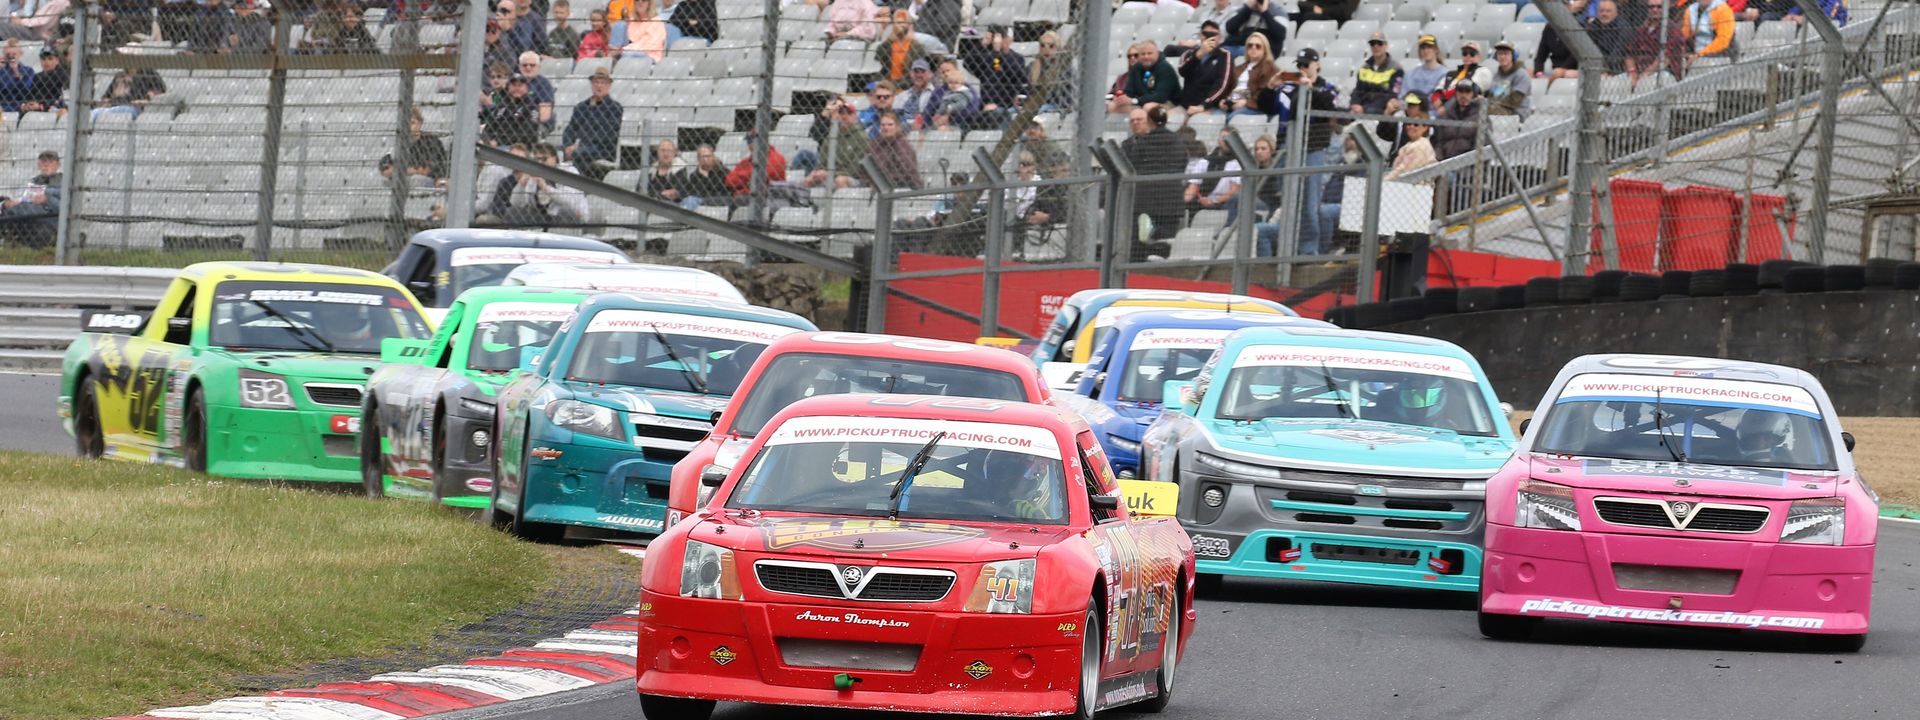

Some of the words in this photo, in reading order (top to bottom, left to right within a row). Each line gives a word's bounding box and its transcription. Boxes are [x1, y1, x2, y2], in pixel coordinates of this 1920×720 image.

[608, 319, 779, 341] WWW.PICKUPTRUCKRACING.C
[1256, 354, 1450, 371] WWW.PICKUPTRUCKRACING.COM
[241, 378, 291, 405] 52
[1584, 383, 1792, 403] WWW.PICKUPTRUCKRACING.COM
[793, 427, 1032, 448] WWW.PICKUPTRUCKRACING.COM
[1611, 468, 1759, 481] Workwear
[987, 577, 1019, 602] 41
[796, 611, 840, 623] Aaron
[844, 613, 909, 628] Thompson
[1520, 598, 1824, 629] pickuptruckracing.com
